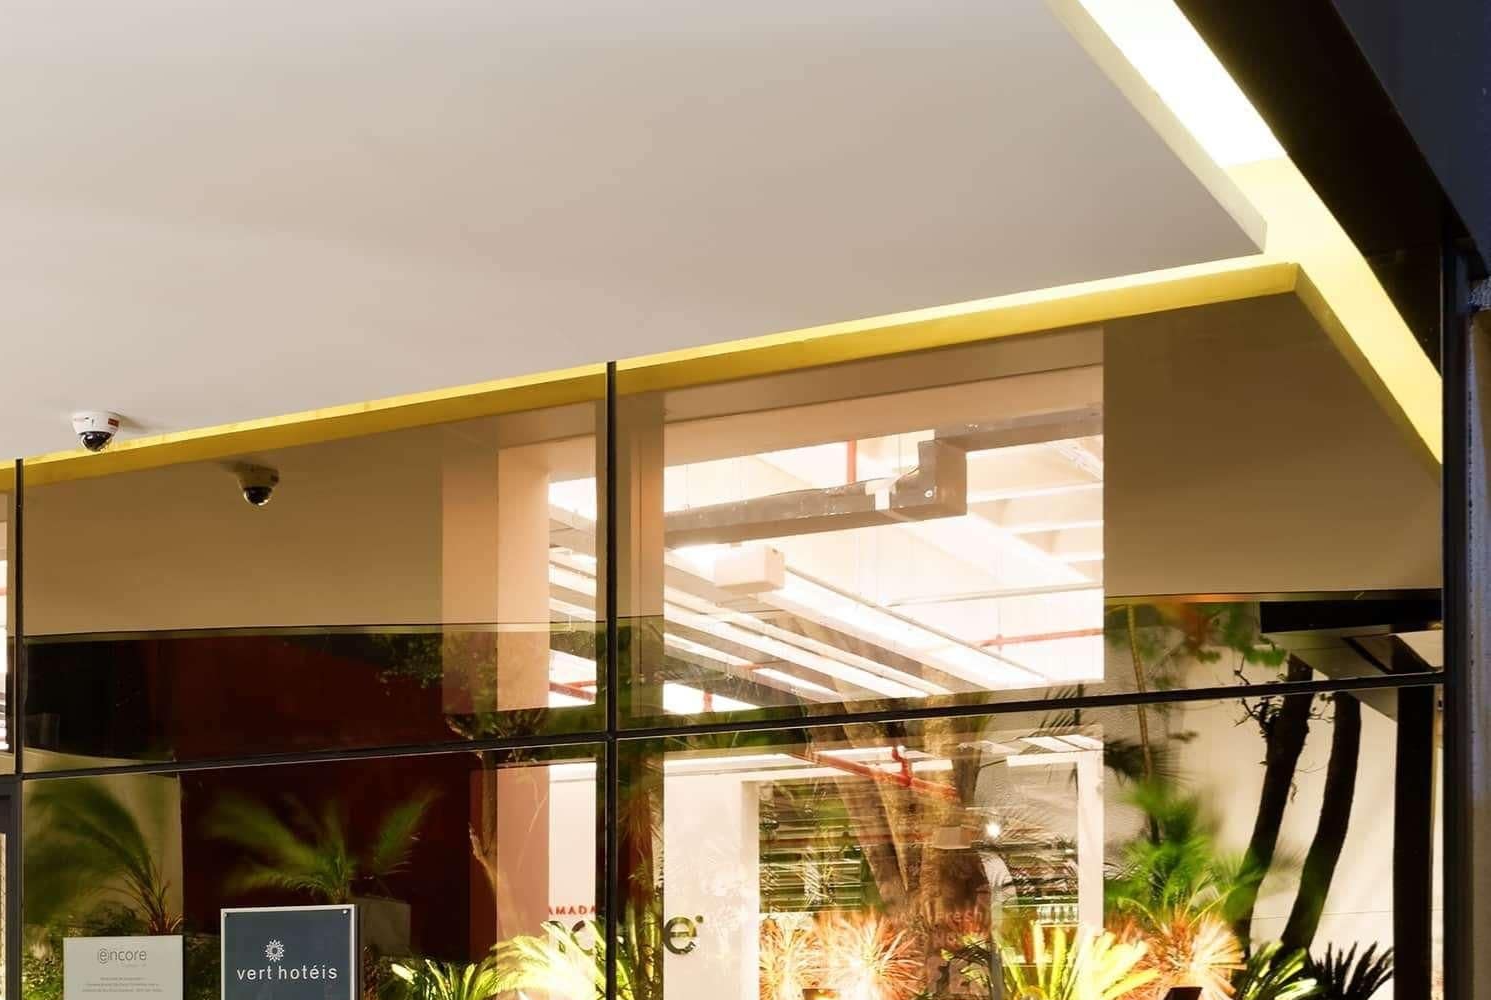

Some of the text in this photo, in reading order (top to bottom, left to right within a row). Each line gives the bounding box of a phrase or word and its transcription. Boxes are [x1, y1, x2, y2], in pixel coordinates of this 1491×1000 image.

[98, 948, 148, 963] encore
[236, 964, 338, 980] vert hotéis
